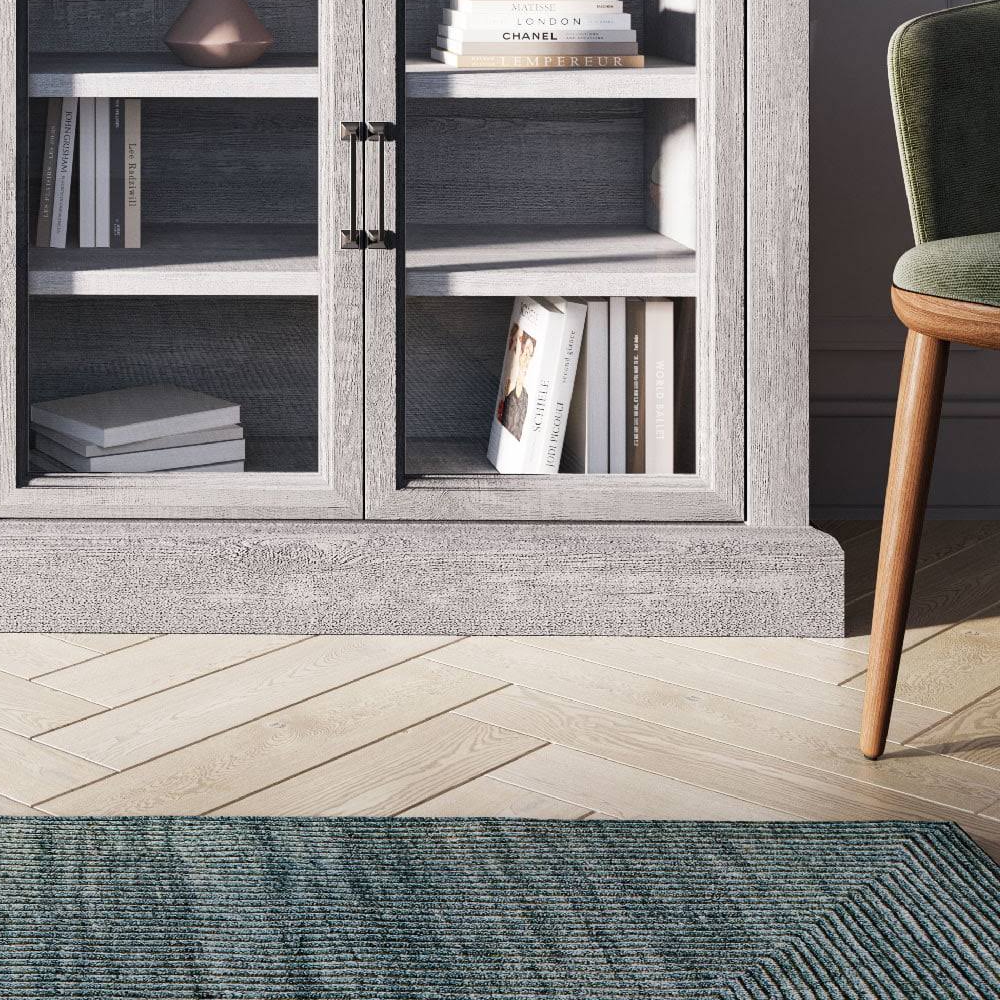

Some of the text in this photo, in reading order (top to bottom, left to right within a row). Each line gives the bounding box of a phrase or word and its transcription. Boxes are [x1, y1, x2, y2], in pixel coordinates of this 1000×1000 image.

[502, 32, 558, 41] CHANEL
[516, 17, 582, 26] LONDON
[64, 111, 73, 134] JOHN
[61, 134, 71, 173] GRISHAM
[128, 143, 137, 207] Lee Radziwill
[562, 330, 576, 384] second glance
[533, 379, 550, 433] SCHIELE
[655, 360, 665, 440] WORLD BALLET
[546, 400, 565, 468] JODI PICOULT
